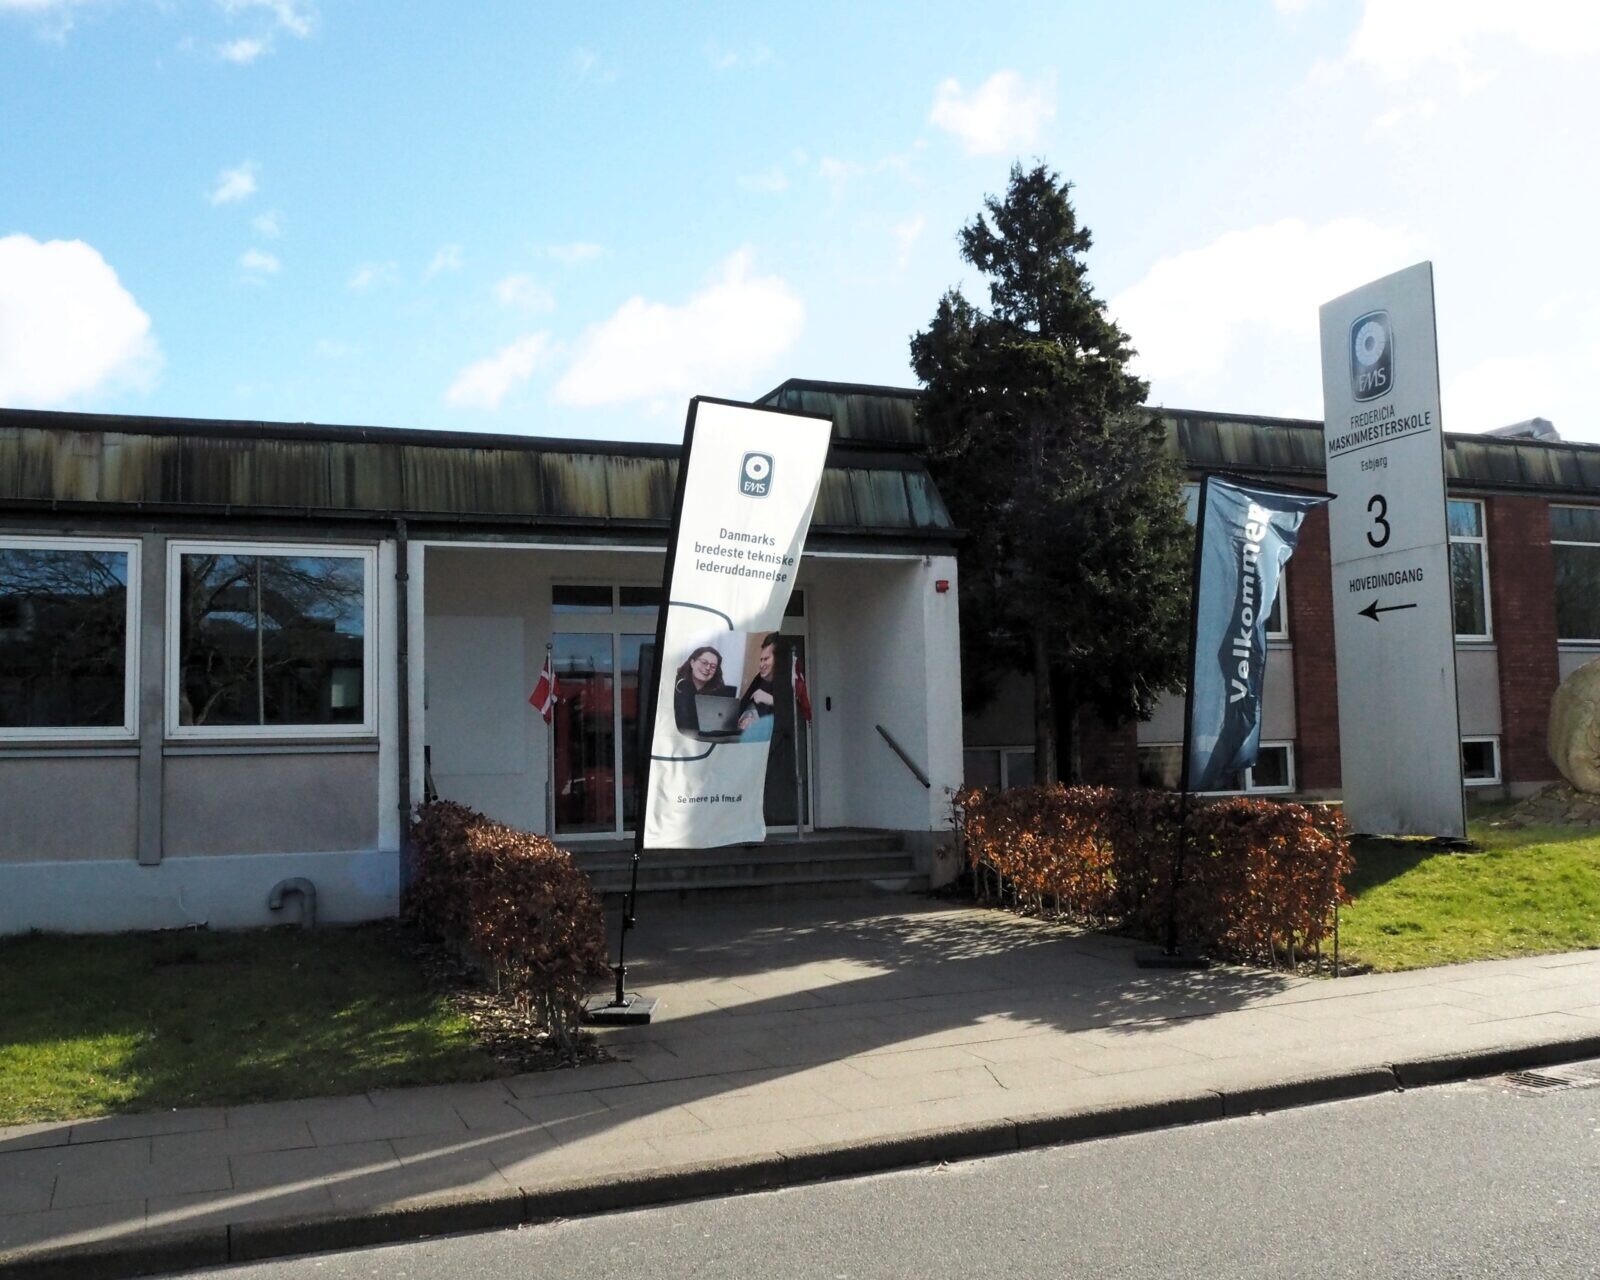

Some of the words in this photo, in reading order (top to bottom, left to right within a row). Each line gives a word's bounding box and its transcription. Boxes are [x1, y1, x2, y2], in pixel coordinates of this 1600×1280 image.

[1359, 367, 1387, 392] FMS
[1350, 404, 1396, 429] FREDERICIA
[1328, 411, 1432, 453] MASKINMESTERSKOLE
[1360, 456, 1388, 472] Esbjerg
[744, 481, 766, 494] FMS
[1366, 494, 1391, 549] 3
[719, 527, 776, 546] Danmarks
[694, 542, 744, 559] bredeste
[747, 548, 794, 566] tekniske
[696, 559, 788, 583] lederuddannelse
[1349, 568, 1424, 593] HOVEDINDGANG
[677, 795, 687, 804] Se
[689, 796, 709, 804] mere
[710, 793, 720, 804] på
